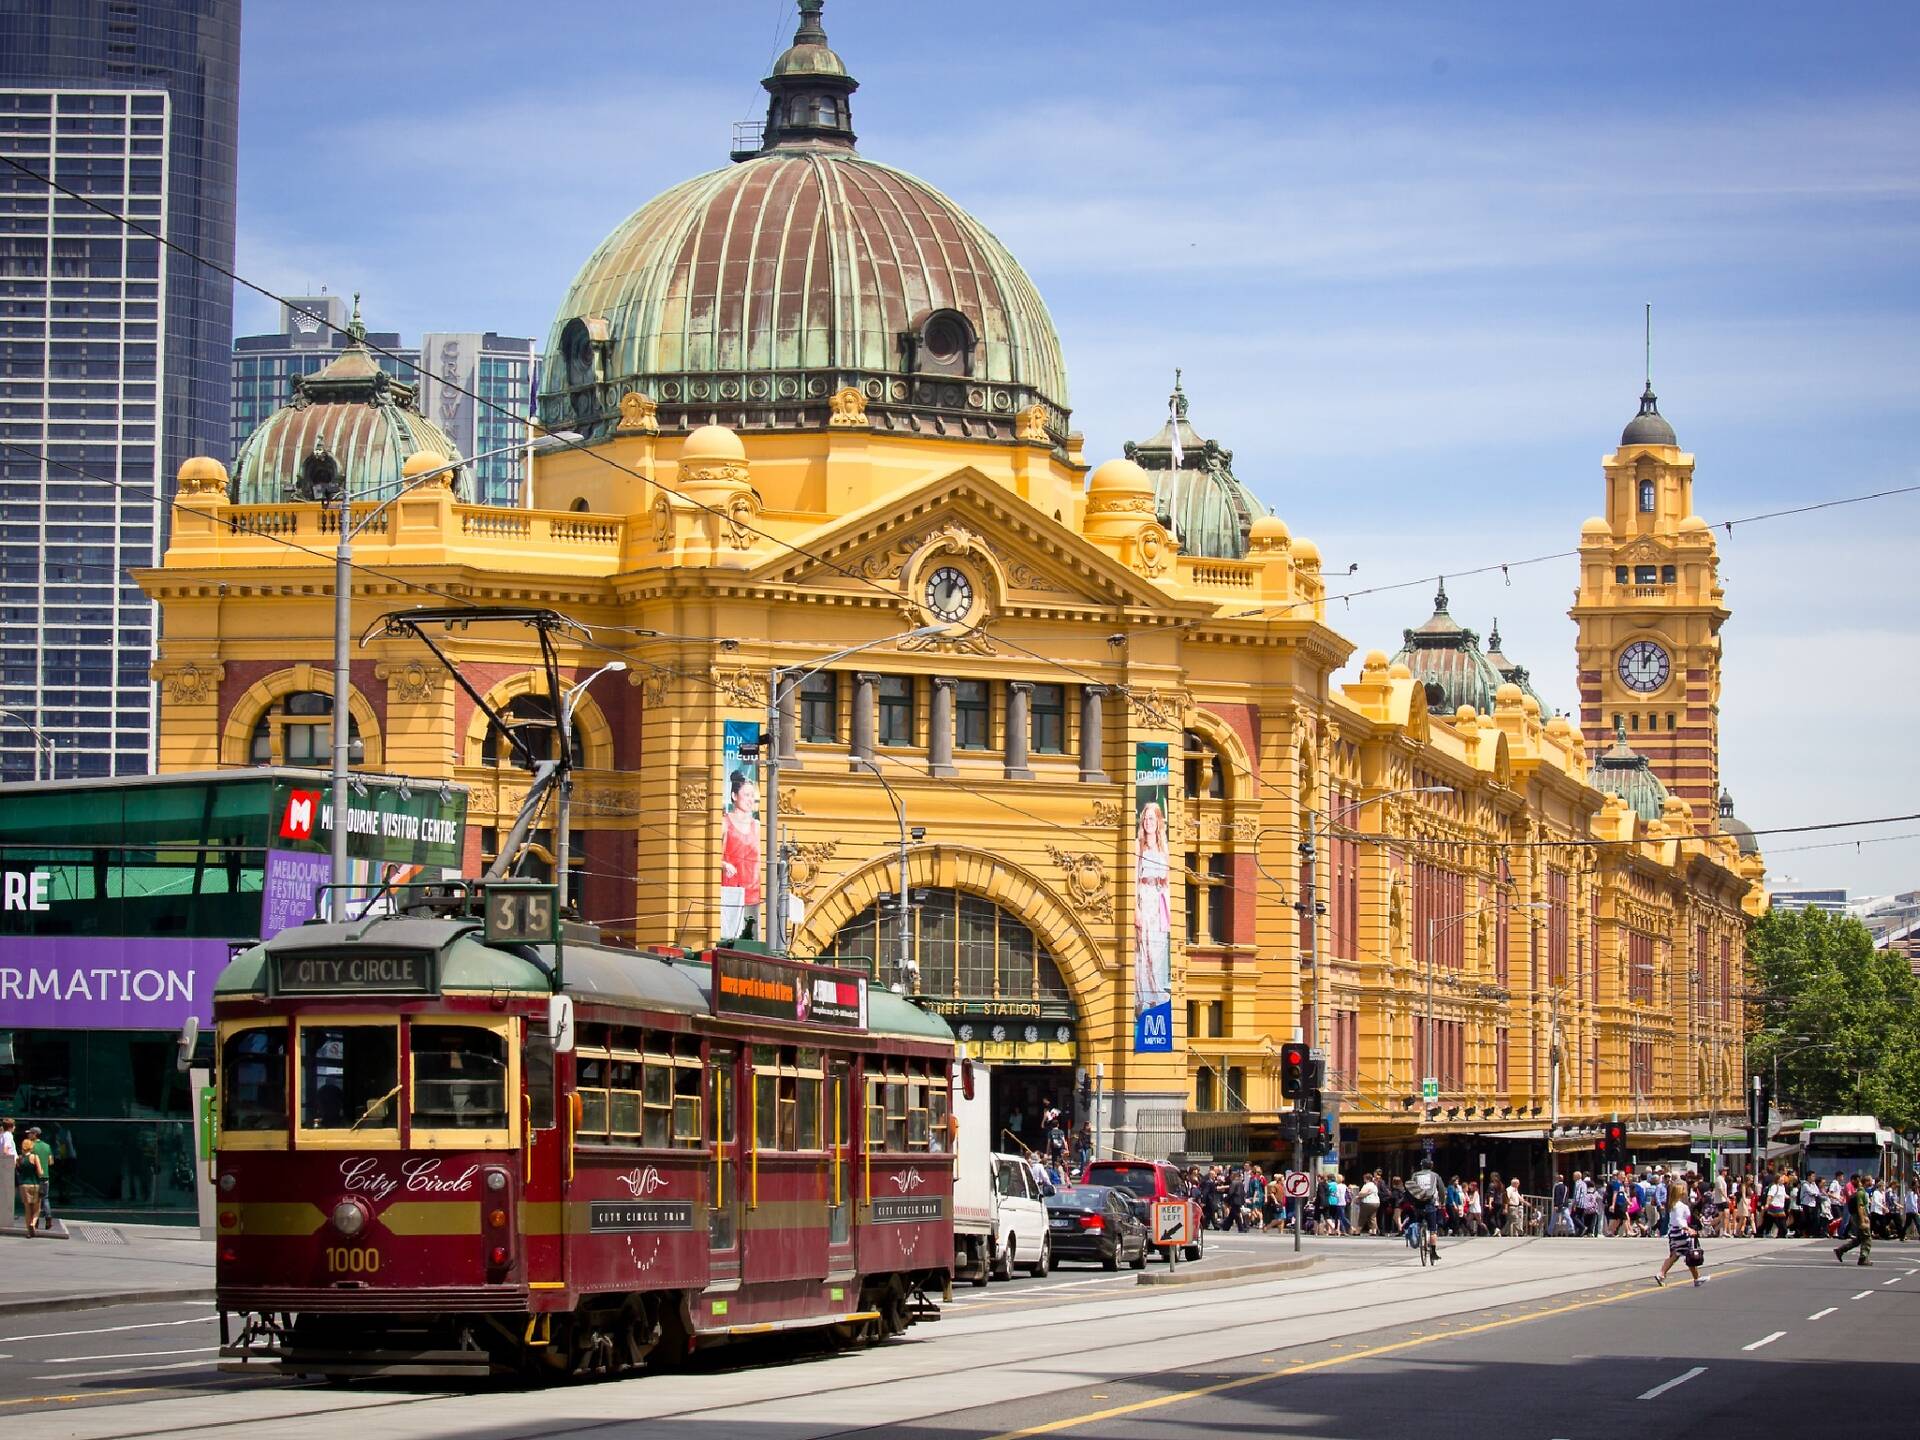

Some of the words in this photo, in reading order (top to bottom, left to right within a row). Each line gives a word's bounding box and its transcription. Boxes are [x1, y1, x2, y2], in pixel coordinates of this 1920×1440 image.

[440, 340, 461, 440] CROWN
[726, 735, 743, 749] my
[1151, 757, 1168, 770] my
[1137, 769, 1168, 780] metro
[321, 804, 379, 835] MOURNE
[382, 812, 418, 841] VISITOR
[421, 818, 457, 845] CENTRE
[272, 860, 329, 883] MELBOURNE
[0, 871, 50, 911] RE
[271, 879, 312, 900] FESTIVAL
[290, 901, 306, 917] OCT
[268, 914, 287, 930] 2012
[300, 961, 344, 982] CITY
[350, 959, 414, 981] CIRCLE
[0, 968, 195, 1002] RMATION
[921, 1002, 968, 1015] TREET
[984, 1003, 1040, 1016] STATION
[1144, 1036, 1167, 1045] METRO
[340, 1158, 399, 1201] City
[402, 1158, 479, 1191] Circle
[600, 1212, 621, 1223] CITY
[626, 1212, 658, 1221] CIRCLE
[664, 1211, 685, 1221] TRAM
[326, 1248, 379, 1272] 1000
